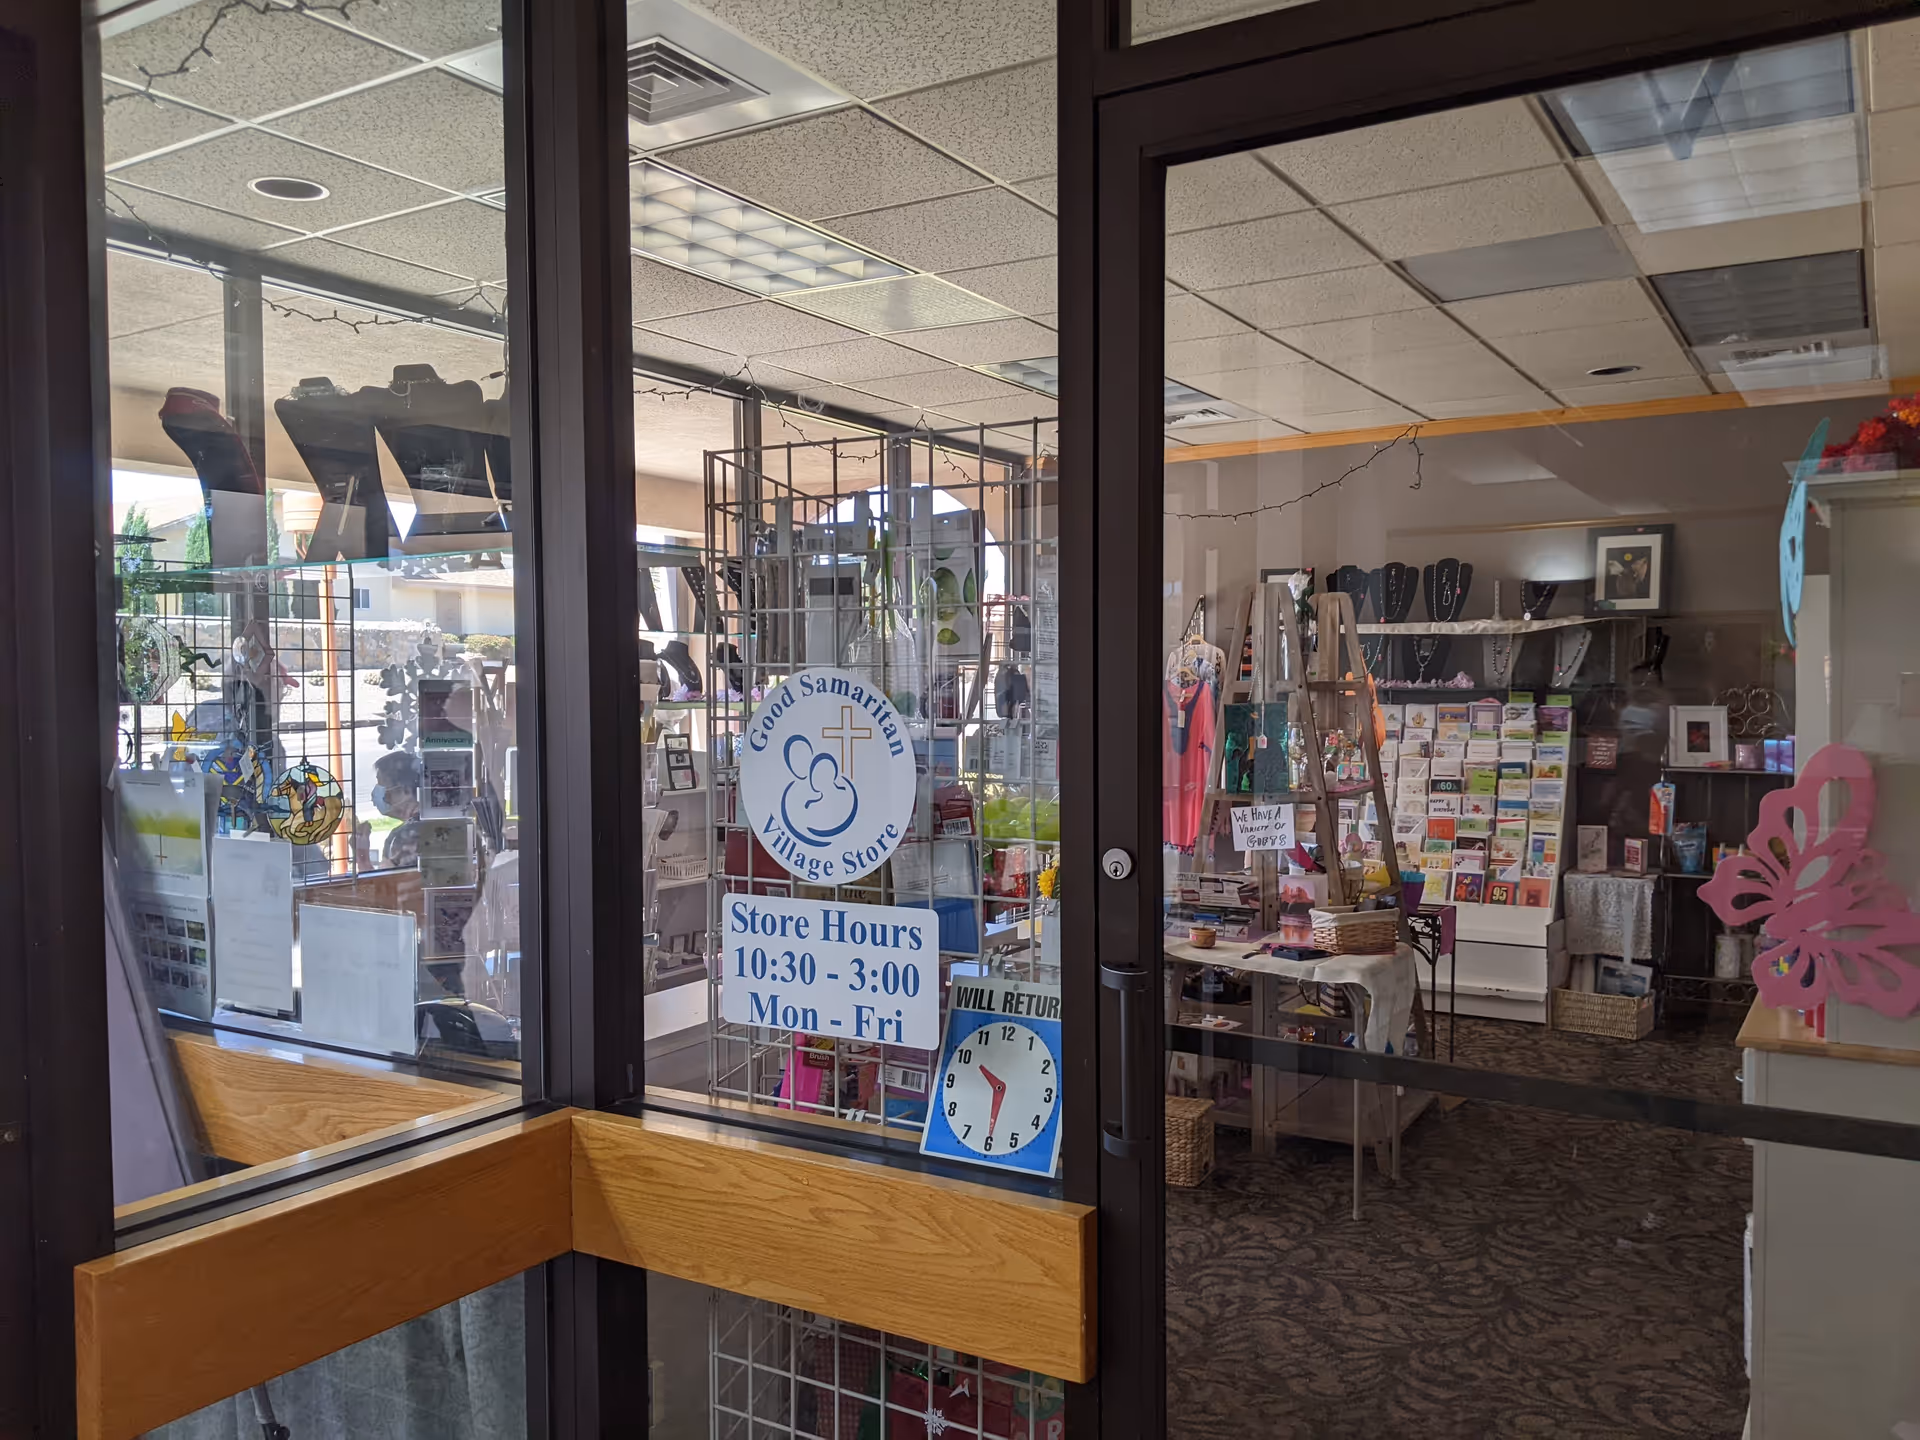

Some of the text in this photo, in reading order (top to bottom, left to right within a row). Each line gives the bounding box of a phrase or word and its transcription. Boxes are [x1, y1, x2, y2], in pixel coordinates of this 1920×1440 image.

[750, 673, 905, 758] Good Samaritan
[1440, 782, 1452, 791] 60
[1233, 806, 1281, 823] WE HAVE A
[763, 813, 899, 880] Village Store
[1247, 834, 1287, 848] GIFTS
[1493, 887, 1508, 900] 95
[731, 901, 922, 950] Store Hours
[734, 946, 816, 985] 10:30
[849, 958, 920, 997] 3:00
[956, 986, 1062, 1020] WILL RETUR
[748, 991, 819, 1031] Mon
[852, 1004, 904, 1043] Fri
[978, 1030, 990, 1046] 11
[1001, 1025, 1016, 1041] 12
[1028, 1036, 1034, 1051] 1
[809, 1052, 830, 1061] Brush
[958, 1049, 972, 1064] 10
[1041, 1059, 1051, 1075] 2
[946, 1073, 955, 1088] 9
[1043, 1087, 1053, 1103] 3
[947, 1101, 957, 1117] 8
[1030, 1114, 1041, 1130] 4
[962, 1124, 972, 1140] 7
[1009, 1132, 1020, 1148] 5
[984, 1136, 994, 1152] 6
